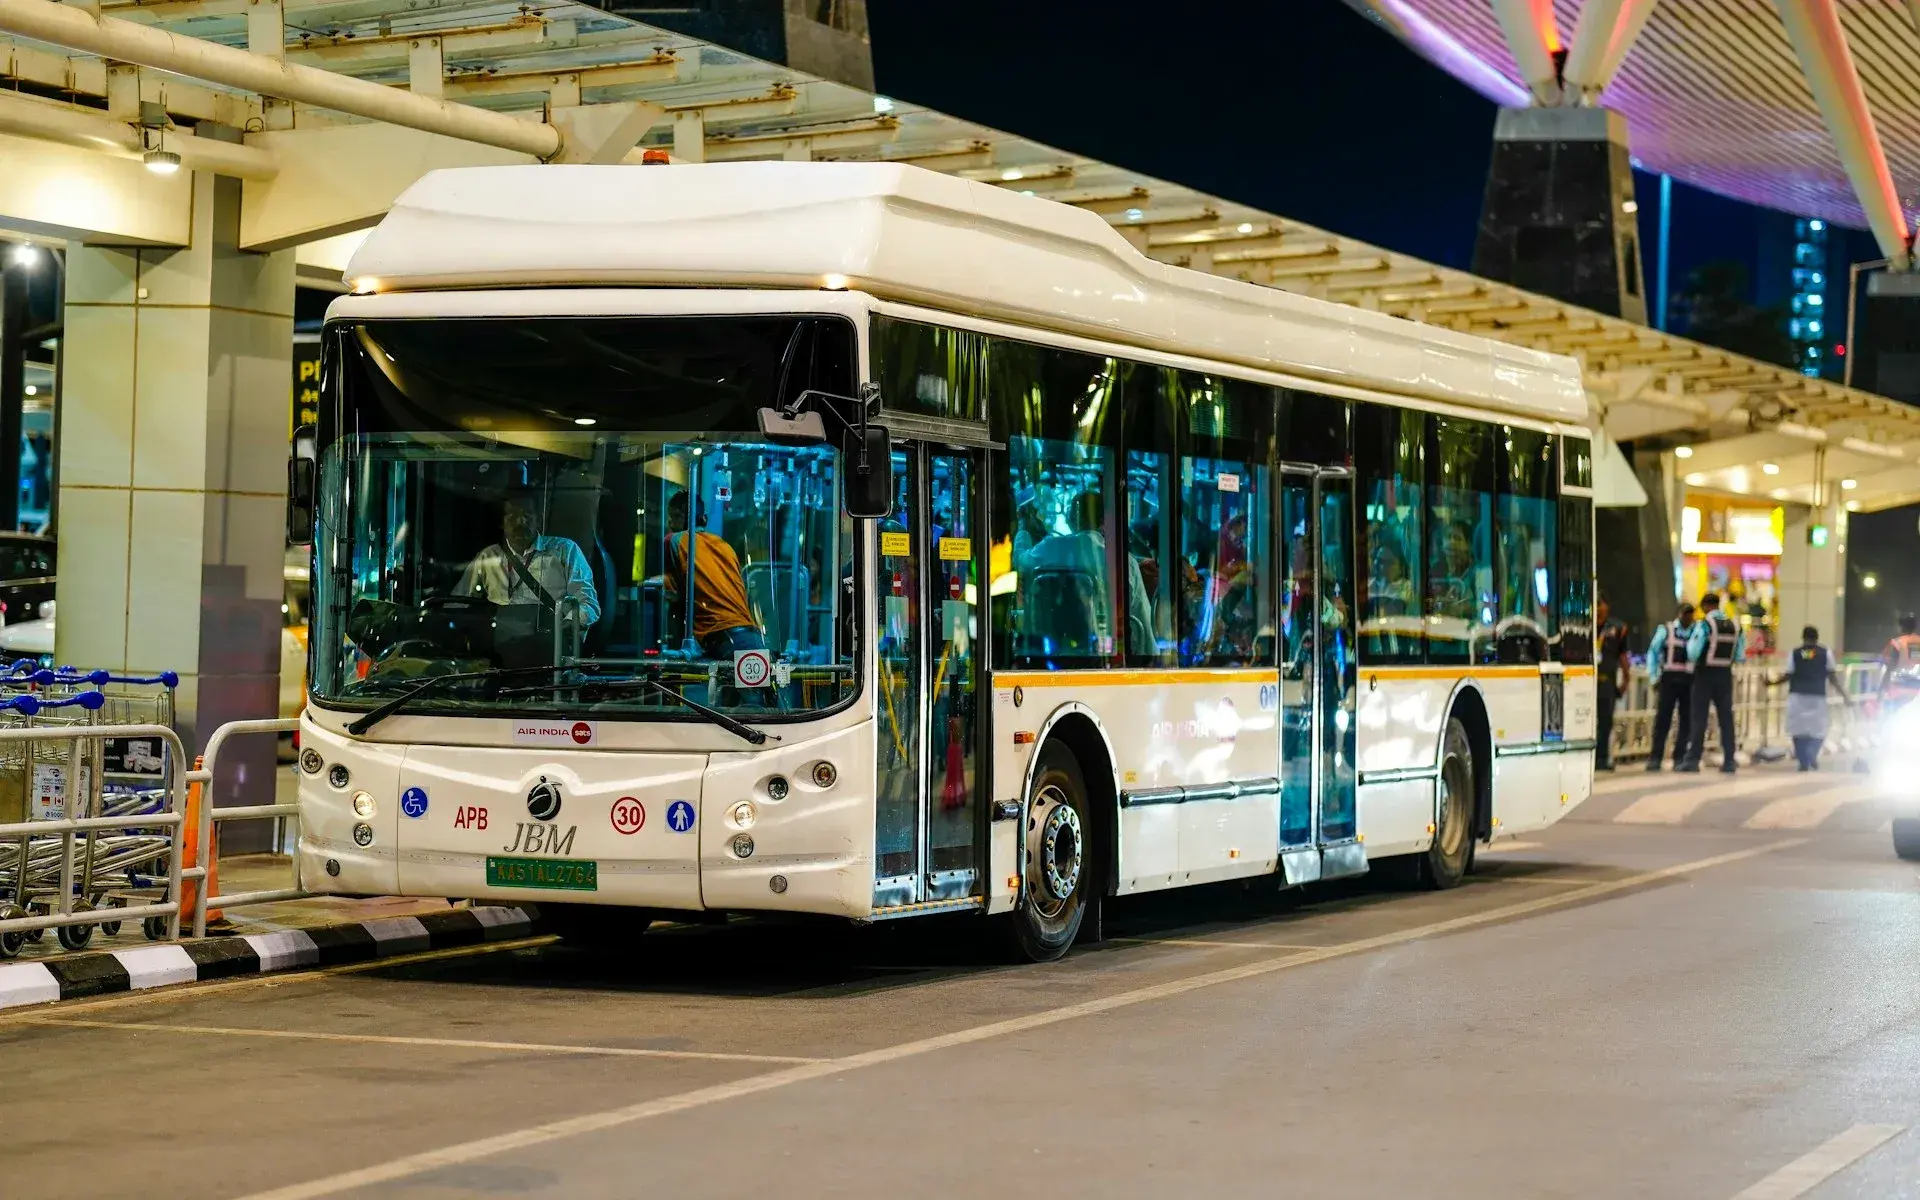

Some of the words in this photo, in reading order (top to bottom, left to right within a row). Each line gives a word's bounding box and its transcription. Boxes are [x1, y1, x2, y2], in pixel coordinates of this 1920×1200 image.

[745, 662, 760, 675] 30
[540, 728, 570, 736] INDIA
[454, 806, 488, 830] APB
[616, 805, 641, 827] 30
[503, 821, 578, 856] JBM
